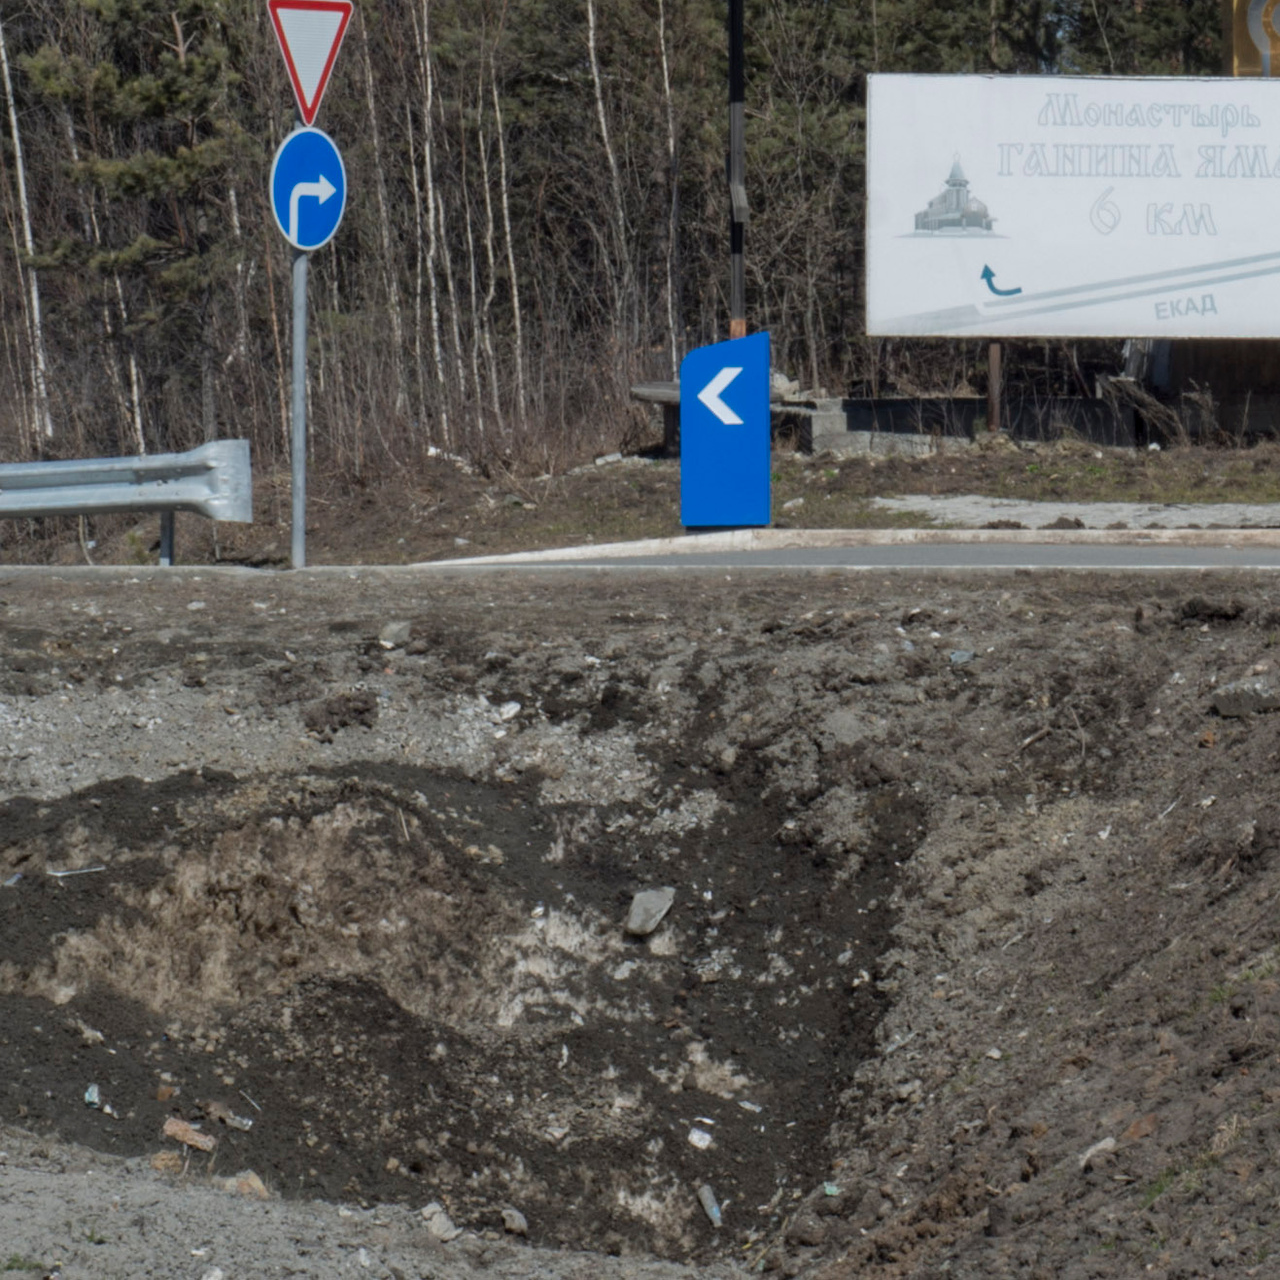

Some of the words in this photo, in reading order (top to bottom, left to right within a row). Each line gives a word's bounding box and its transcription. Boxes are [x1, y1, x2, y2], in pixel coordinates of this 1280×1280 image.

[1037, 92, 1261, 138] Монастырь
[997, 143, 1182, 179] ГАНИНА
[1089, 185, 1122, 236] 6
[1154, 293, 1218, 321] ЕКАД
